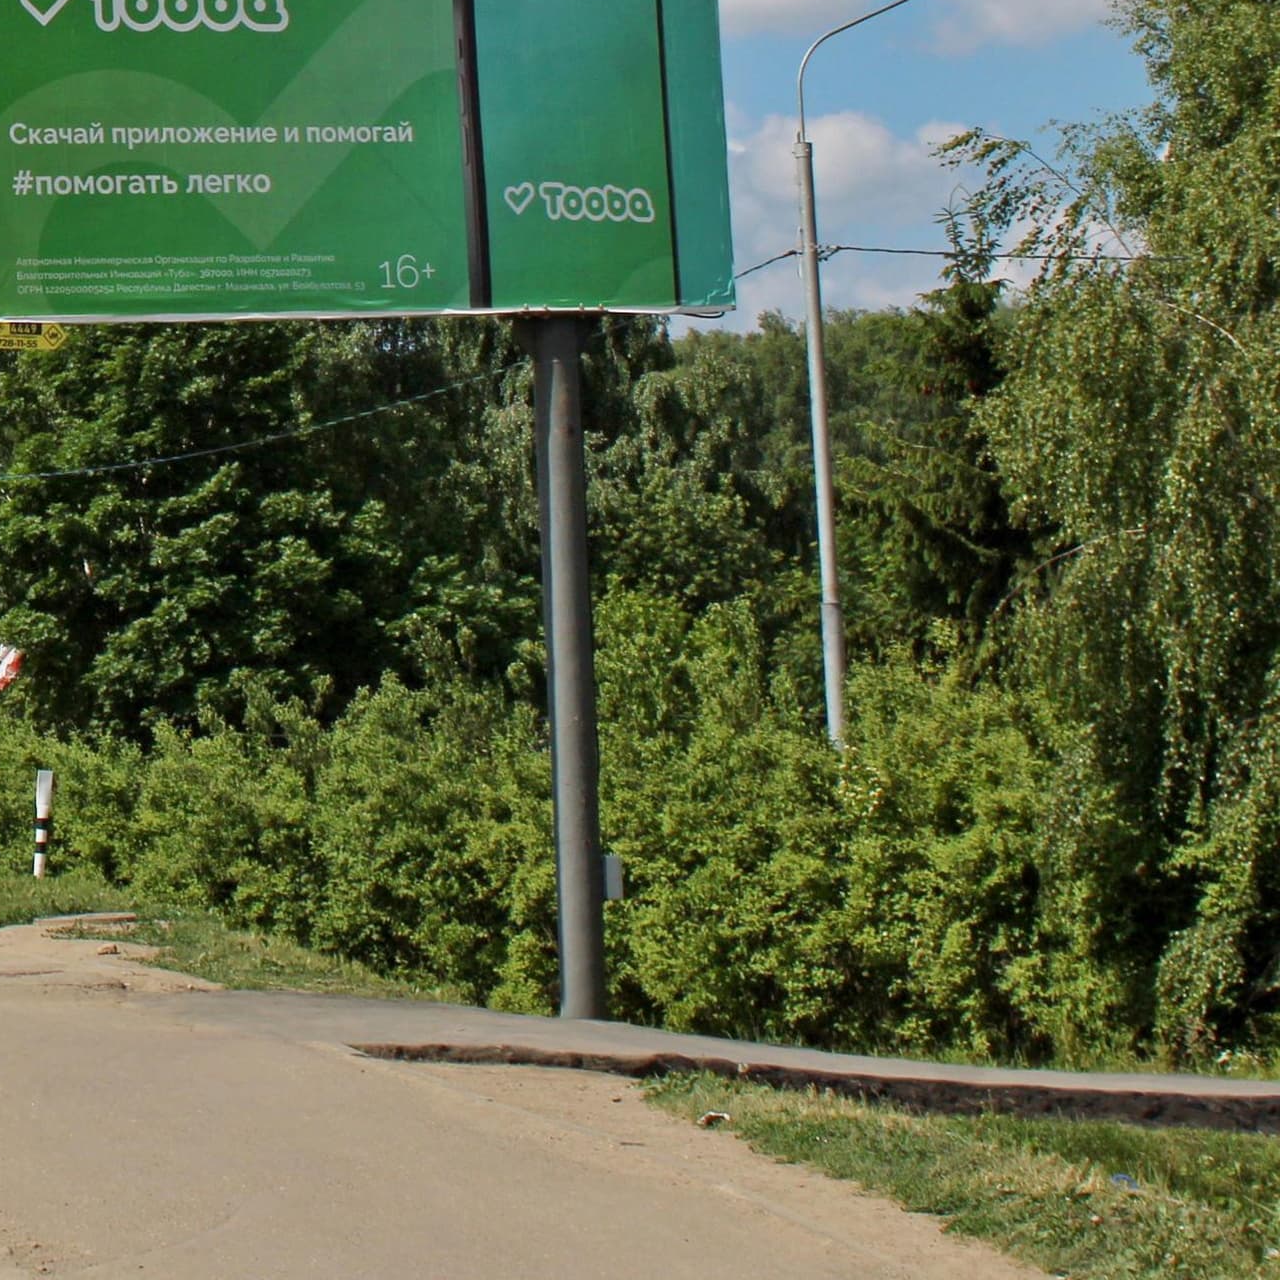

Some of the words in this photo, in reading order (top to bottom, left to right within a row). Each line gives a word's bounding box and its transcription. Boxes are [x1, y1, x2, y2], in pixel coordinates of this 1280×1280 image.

[9, 122, 104, 145] Скачай
[111, 122, 276, 149] приложение
[284, 127, 299, 143] и
[306, 121, 413, 143] помогай
[12, 169, 178, 195] #помогать
[185, 172, 271, 194] легко
[539, 181, 655, 223] Tooba
[378, 253, 437, 289] 16+
